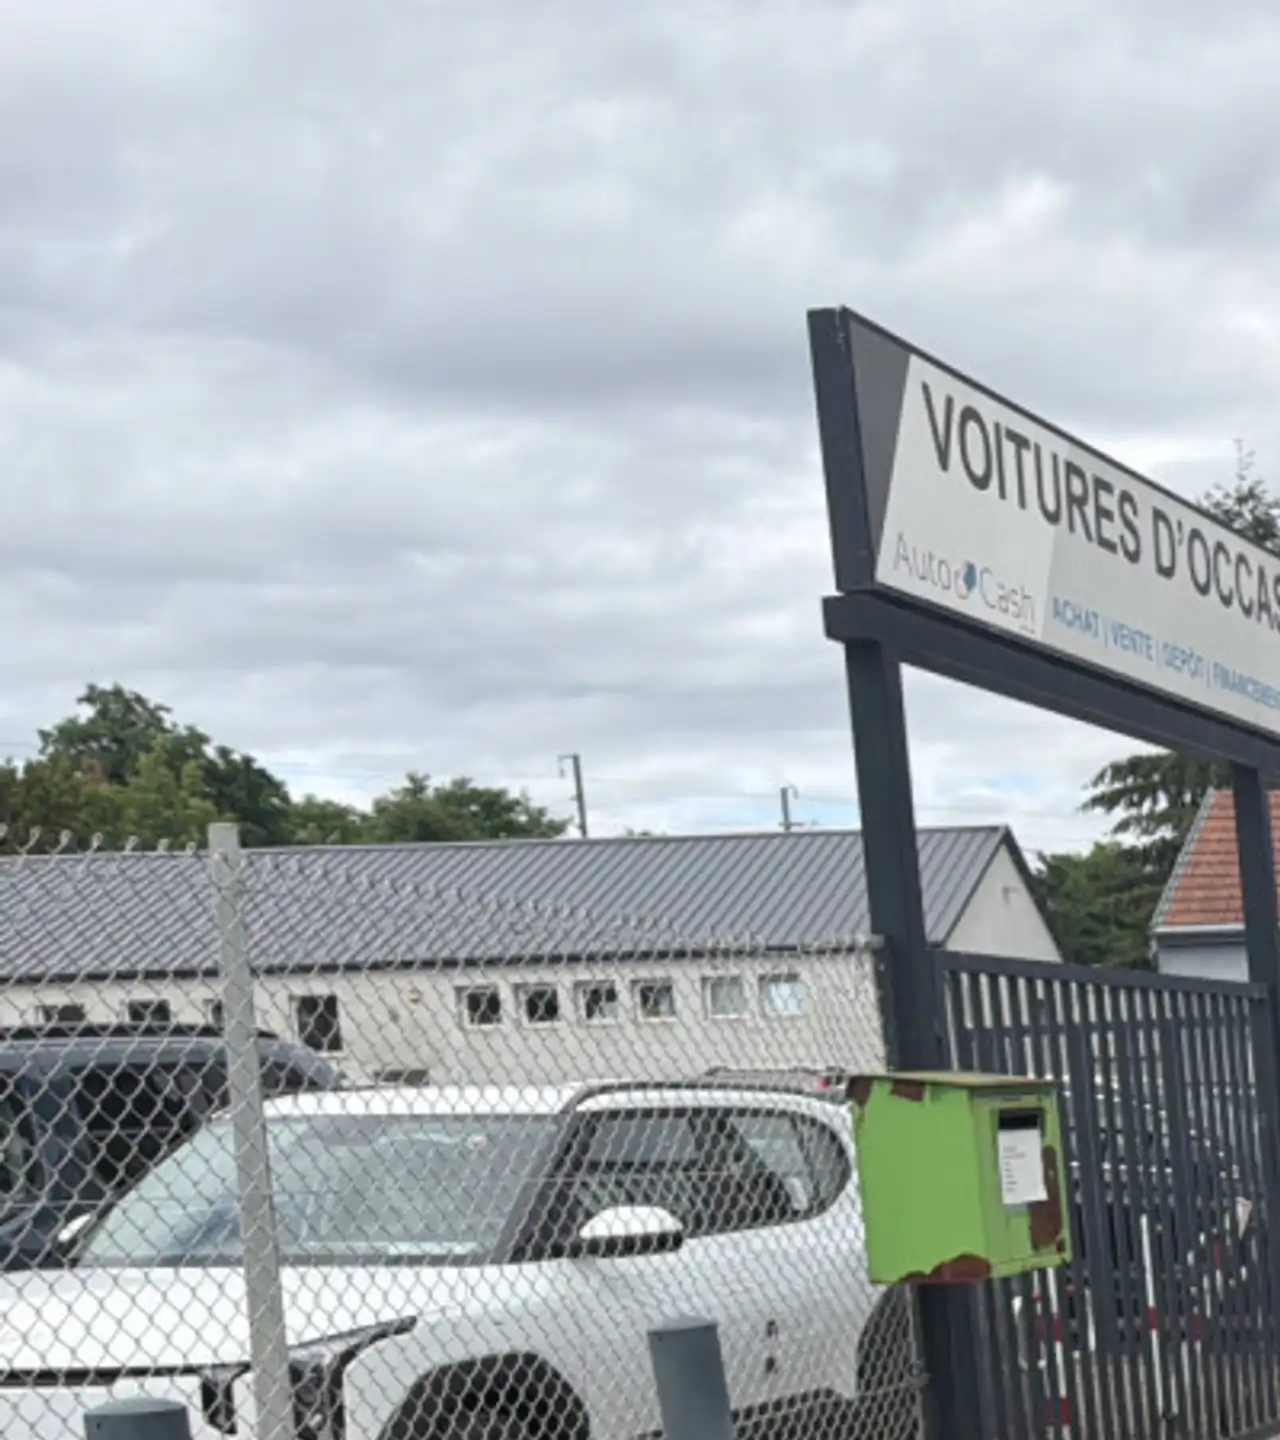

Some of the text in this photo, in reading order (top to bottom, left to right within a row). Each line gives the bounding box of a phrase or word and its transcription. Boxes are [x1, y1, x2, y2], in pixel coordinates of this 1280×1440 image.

[922, 381, 1141, 564] VOITURES
[1051, 596, 1101, 639] ACHAT
[1109, 620, 1154, 662] VENTE
